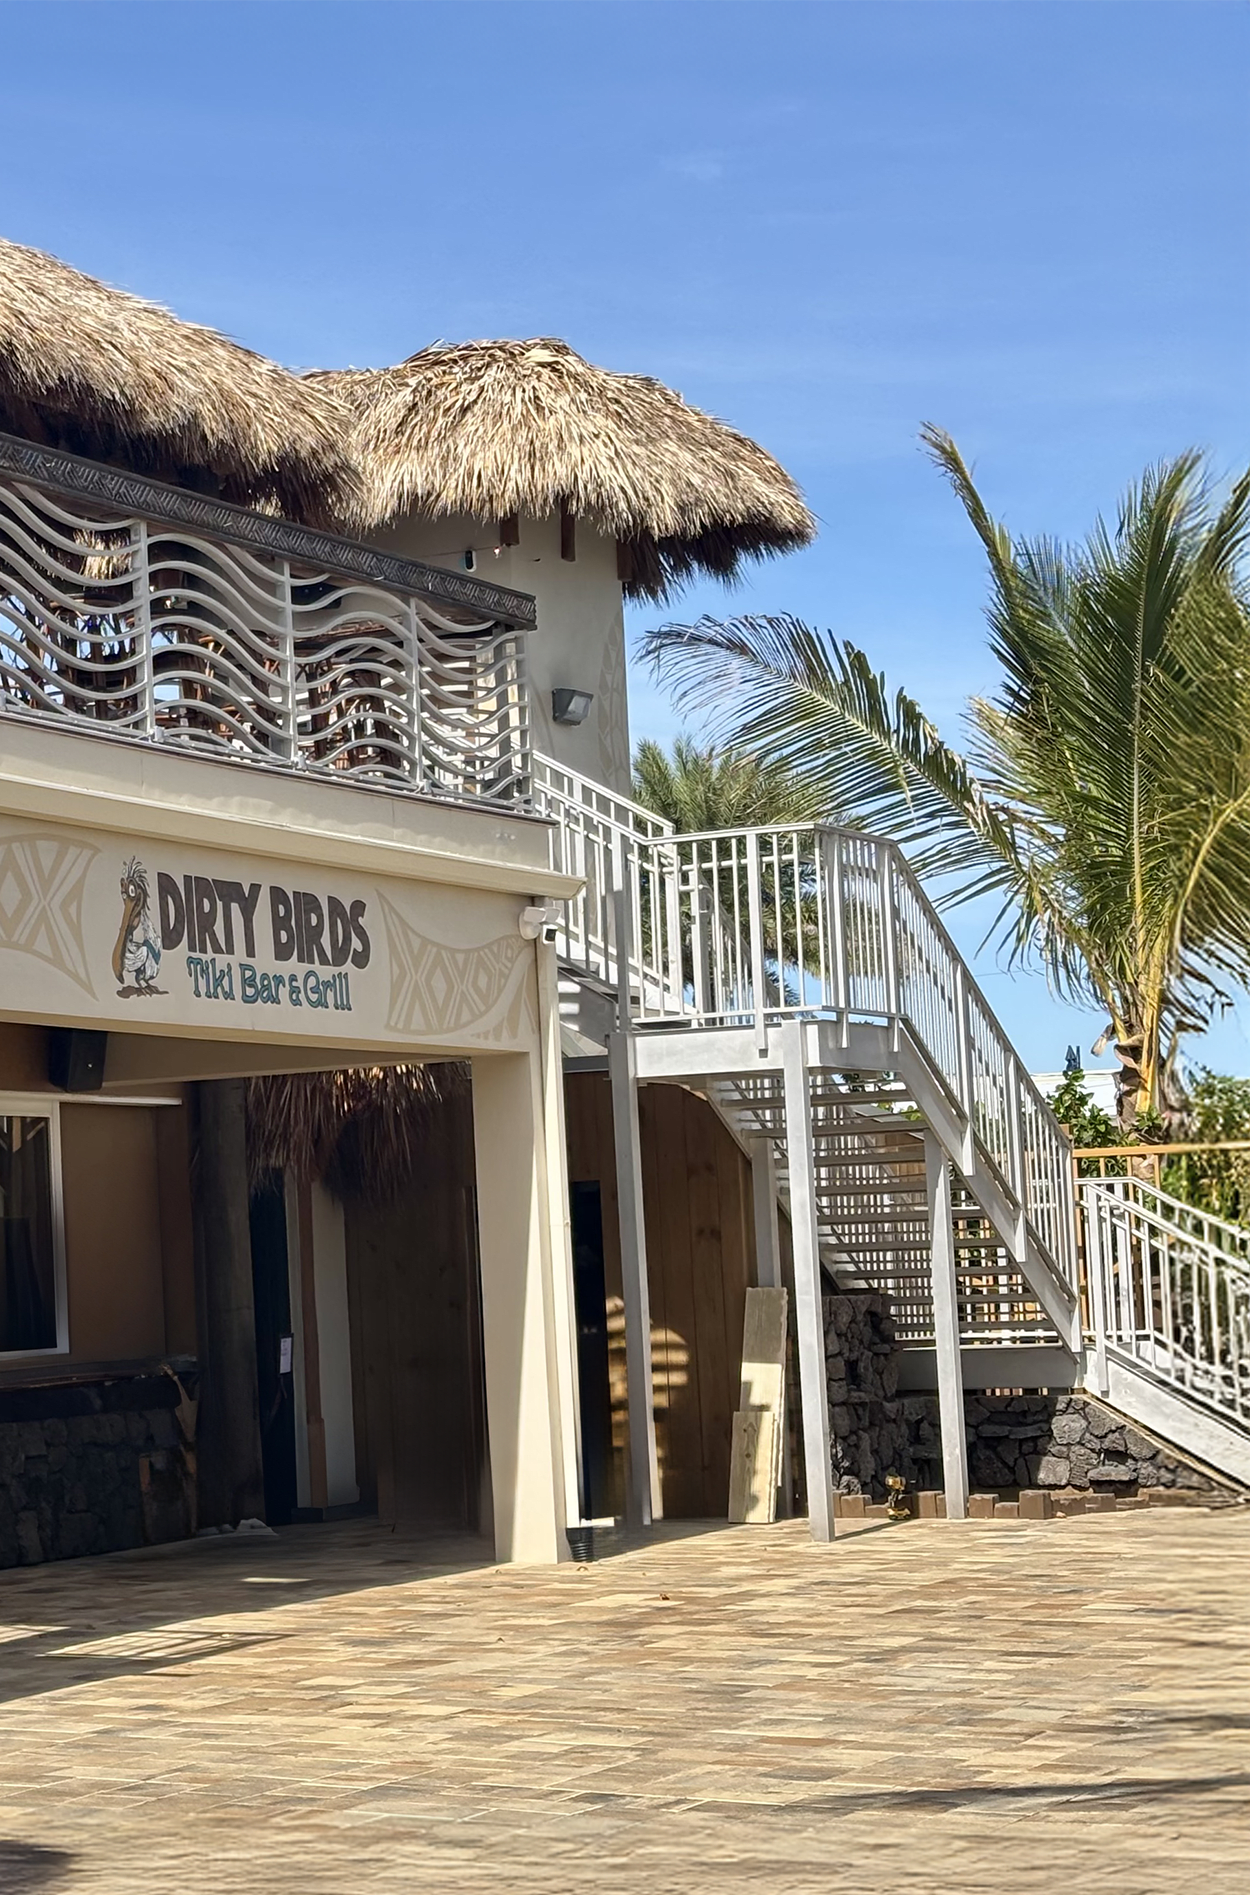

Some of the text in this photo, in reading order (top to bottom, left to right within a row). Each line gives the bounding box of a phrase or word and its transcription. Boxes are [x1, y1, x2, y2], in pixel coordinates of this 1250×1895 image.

[157, 871, 371, 970] DIRTY BIRDS
[187, 955, 352, 1012] Tiki Bar & Grill
